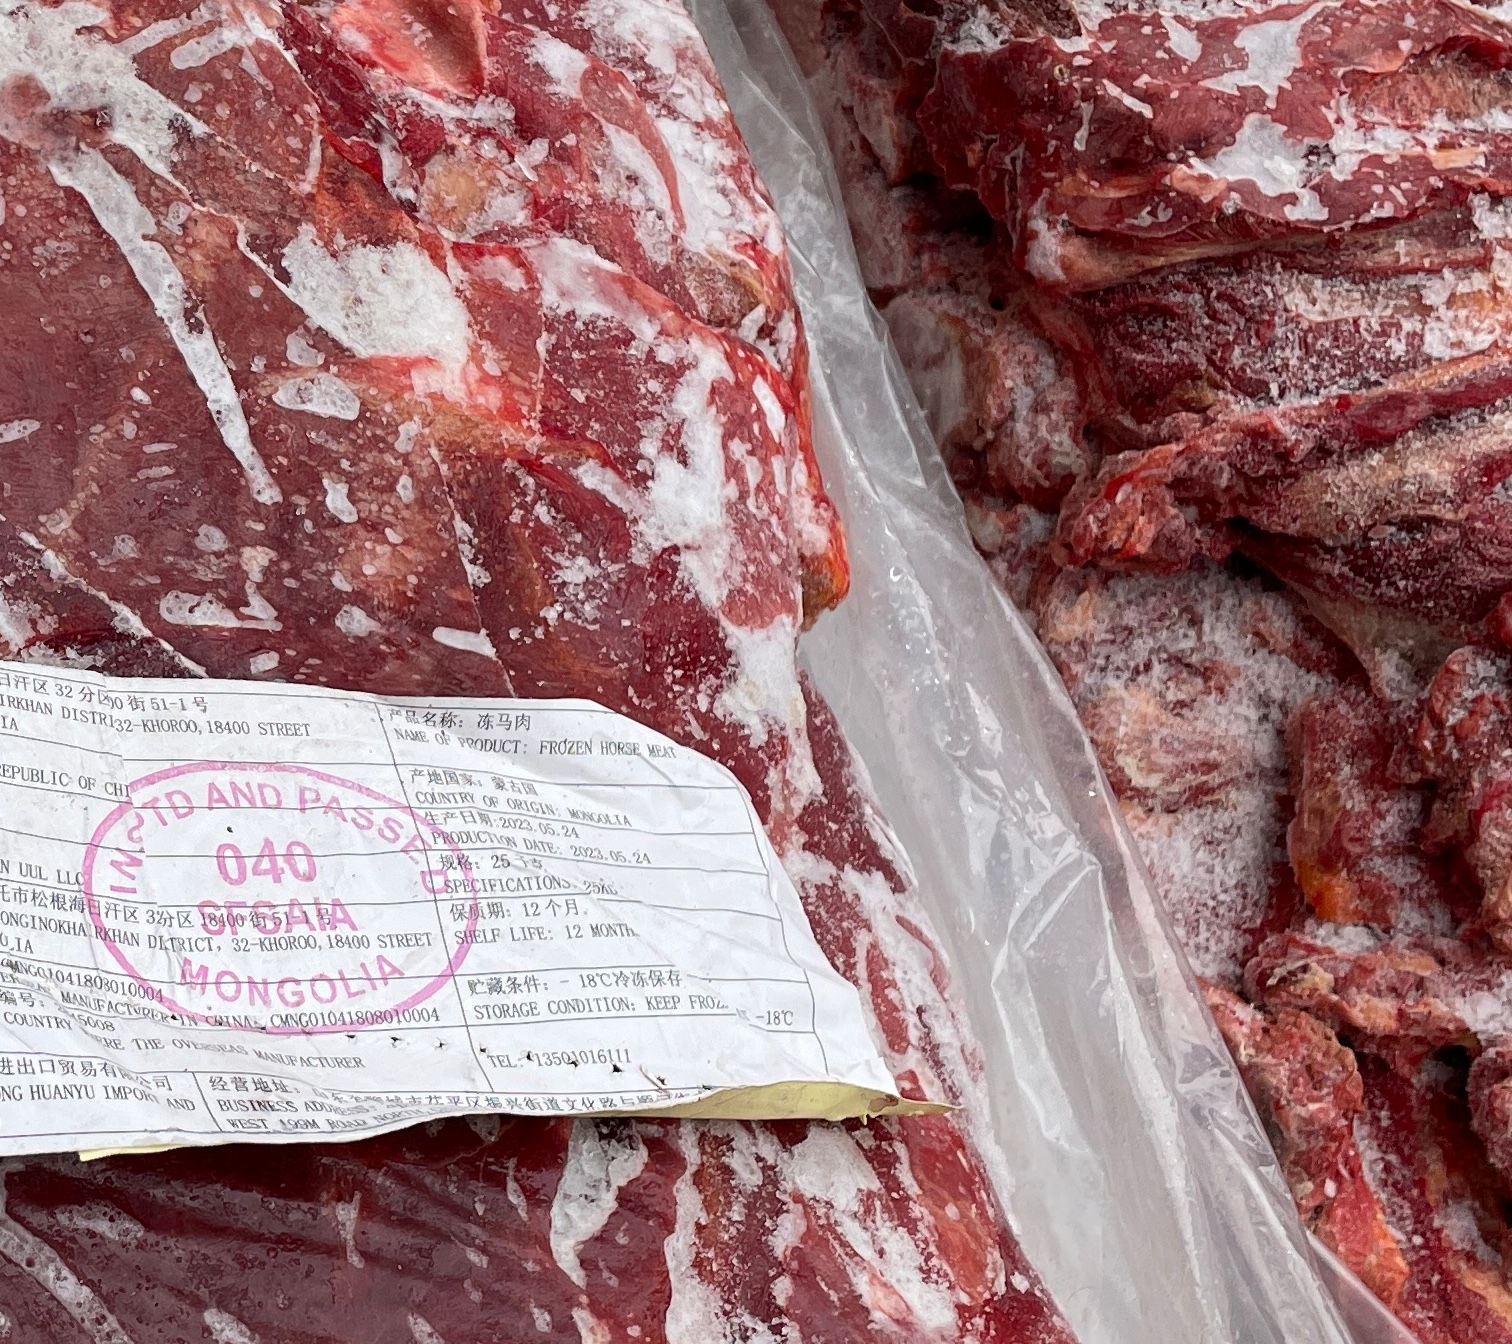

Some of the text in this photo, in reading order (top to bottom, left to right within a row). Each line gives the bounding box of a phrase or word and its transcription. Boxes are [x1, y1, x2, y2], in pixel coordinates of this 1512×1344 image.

[258, 722, 311, 737] STREET
[394, 727, 677, 760] NAME OF PRODUCT: FROZEN HORSE MEAT
[78, 775, 97, 790] OF
[207, 780, 283, 810] AND
[415, 791, 633, 827] COUNTRY OF ORIGIN: MONGOLIA
[215, 836, 317, 888] 040
[524, 838, 562, 855] DATE:
[569, 845, 652, 865] 2023.05.24
[19, 862, 49, 881] UUL
[57, 869, 85, 886] LLC
[377, 931, 433, 949] STREET
[455, 927, 500, 946] SHELF
[511, 926, 554, 942] LIFE:
[565, 924, 584, 939] 12
[179, 953, 406, 1009] MONGOLIA
[474, 1002, 541, 1021] STORAGE
[547, 996, 635, 1015] CONDITION:
[646, 994, 681, 1011] KEEP
[3, 1010, 73, 1032] COUNTRY
[132, 1038, 166, 1050] THE
[30, 1084, 96, 1101] HUANYU
[166, 1098, 196, 1111] AND
[218, 1099, 299, 1114] BUSINESS
[228, 1118, 269, 1131] WEST
